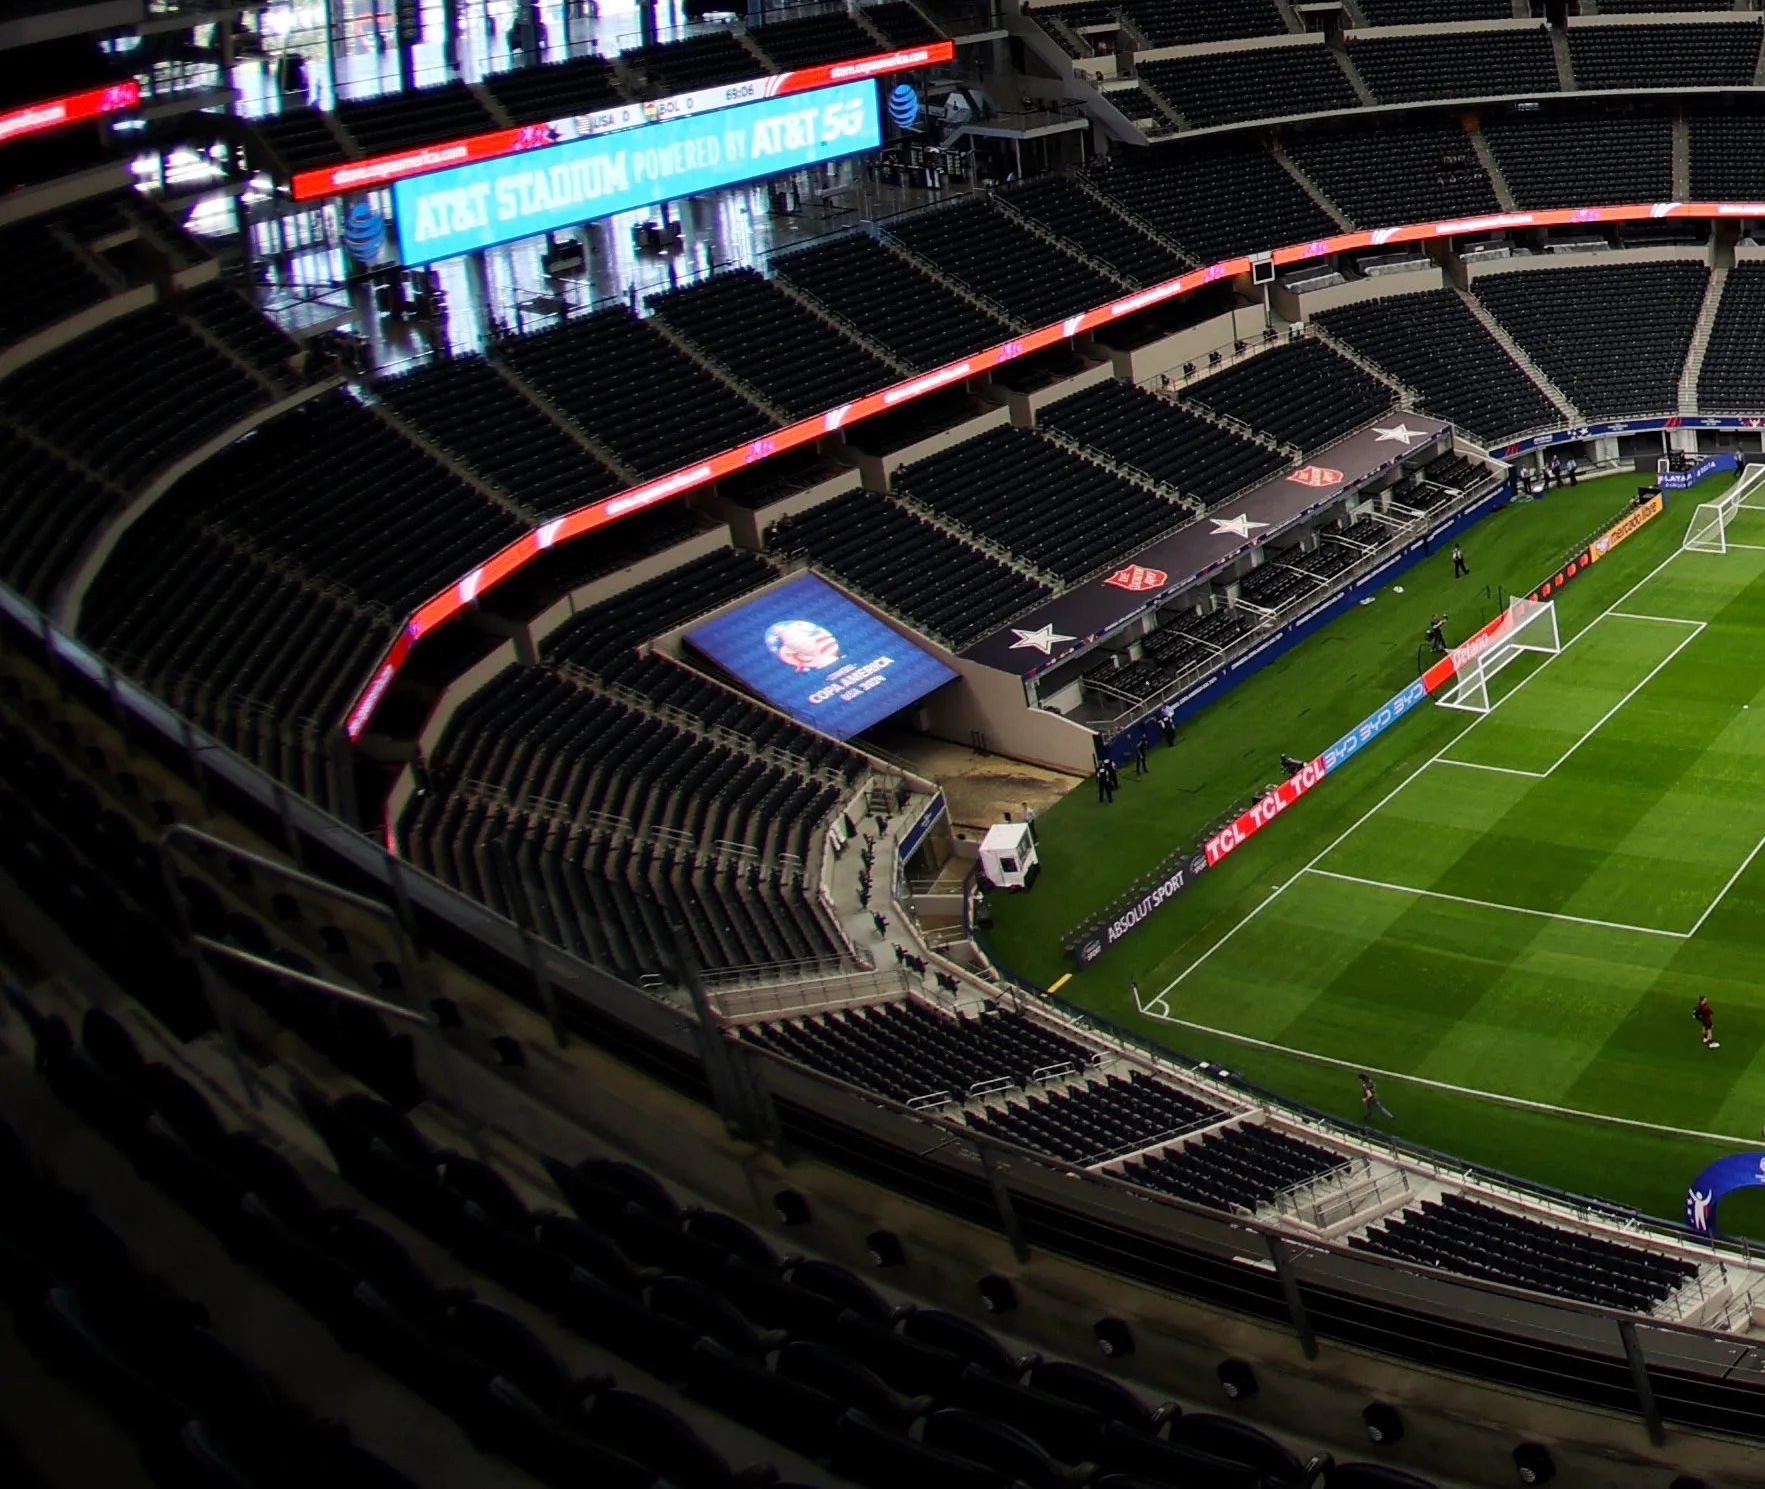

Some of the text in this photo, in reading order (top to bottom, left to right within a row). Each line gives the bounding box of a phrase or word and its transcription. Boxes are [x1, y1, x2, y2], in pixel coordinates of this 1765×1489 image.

[831, 51, 927, 78] store.copaamerica.com
[592, 85, 755, 130] USA 0 BOL 0 69:06
[414, 98, 864, 242] AT&T STADIUM POWERED BY AT&T 5G
[1610, 504, 1657, 543] mercado libre
[1451, 633, 1489, 669] Betano
[807, 681, 843, 704] COPA
[840, 655, 895, 687] AMERICA
[840, 675, 887, 702] USA 2024
[1323, 684, 1425, 768] BYD BYD BYD
[1206, 764, 1325, 860] TCL TCL TCL
[1107, 870, 1186, 943] ABSOLUT SPORT
